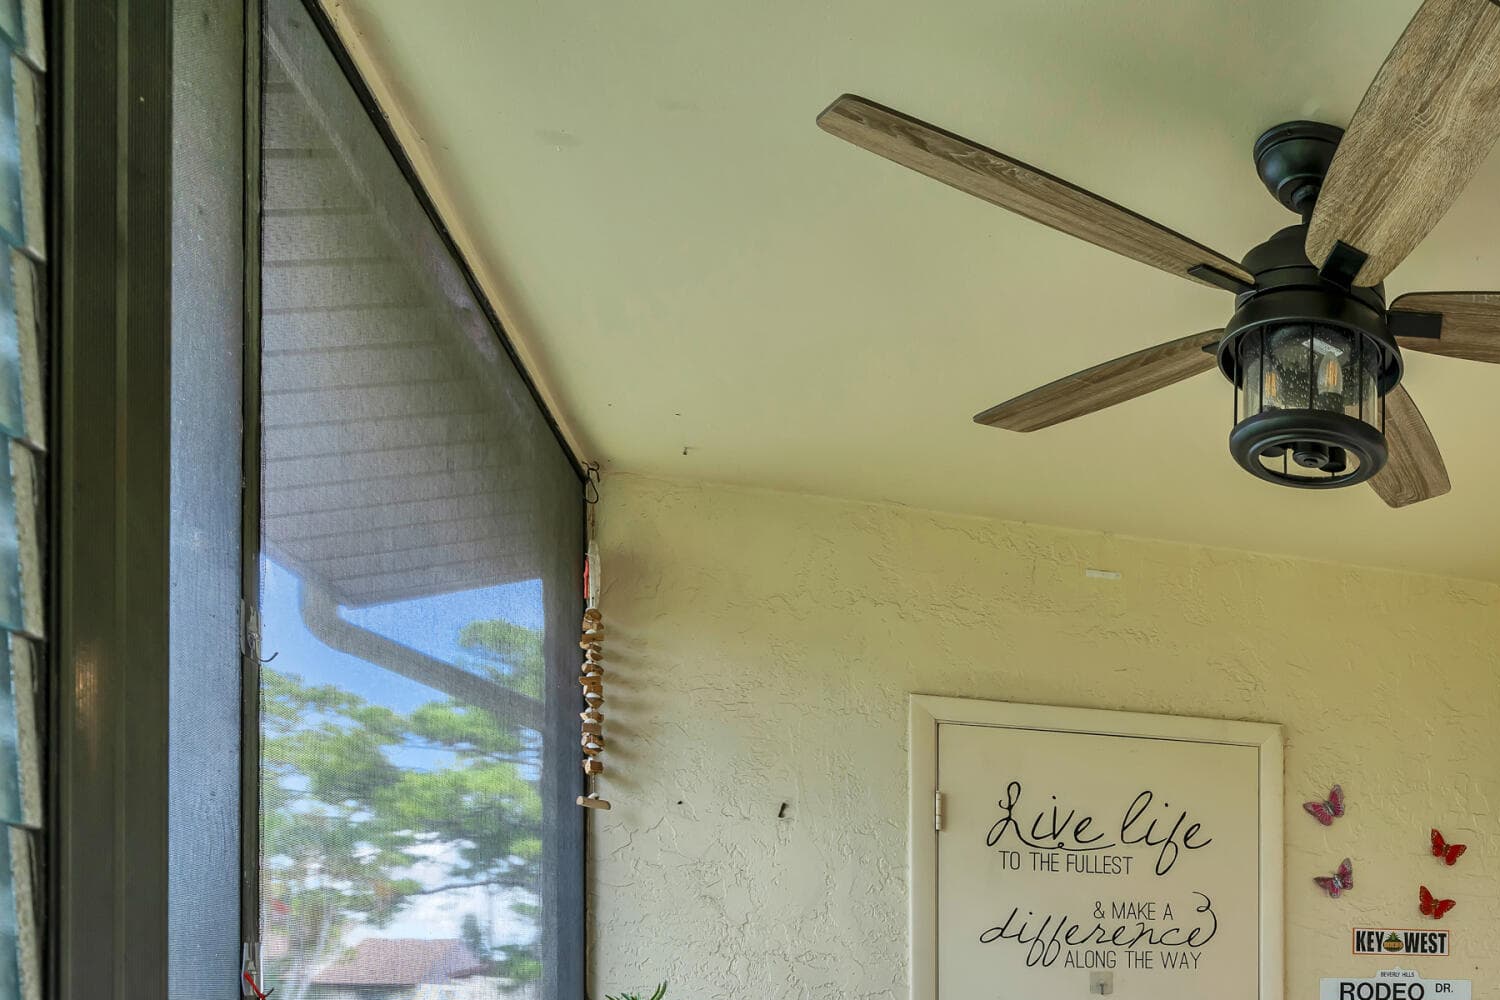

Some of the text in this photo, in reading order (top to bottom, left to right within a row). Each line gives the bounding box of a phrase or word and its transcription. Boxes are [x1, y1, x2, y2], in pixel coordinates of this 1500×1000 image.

[986, 781, 1212, 876] Live life
[999, 851, 1133, 875] TO THE FULLEST
[1093, 902, 1173, 920] & MAKE A
[979, 891, 1218, 968] difference
[1356, 931, 1447, 953] KEY WEST
[1064, 951, 1201, 969] ALONG THE WAY
[1340, 983, 1453, 1000] RODEO DR.
